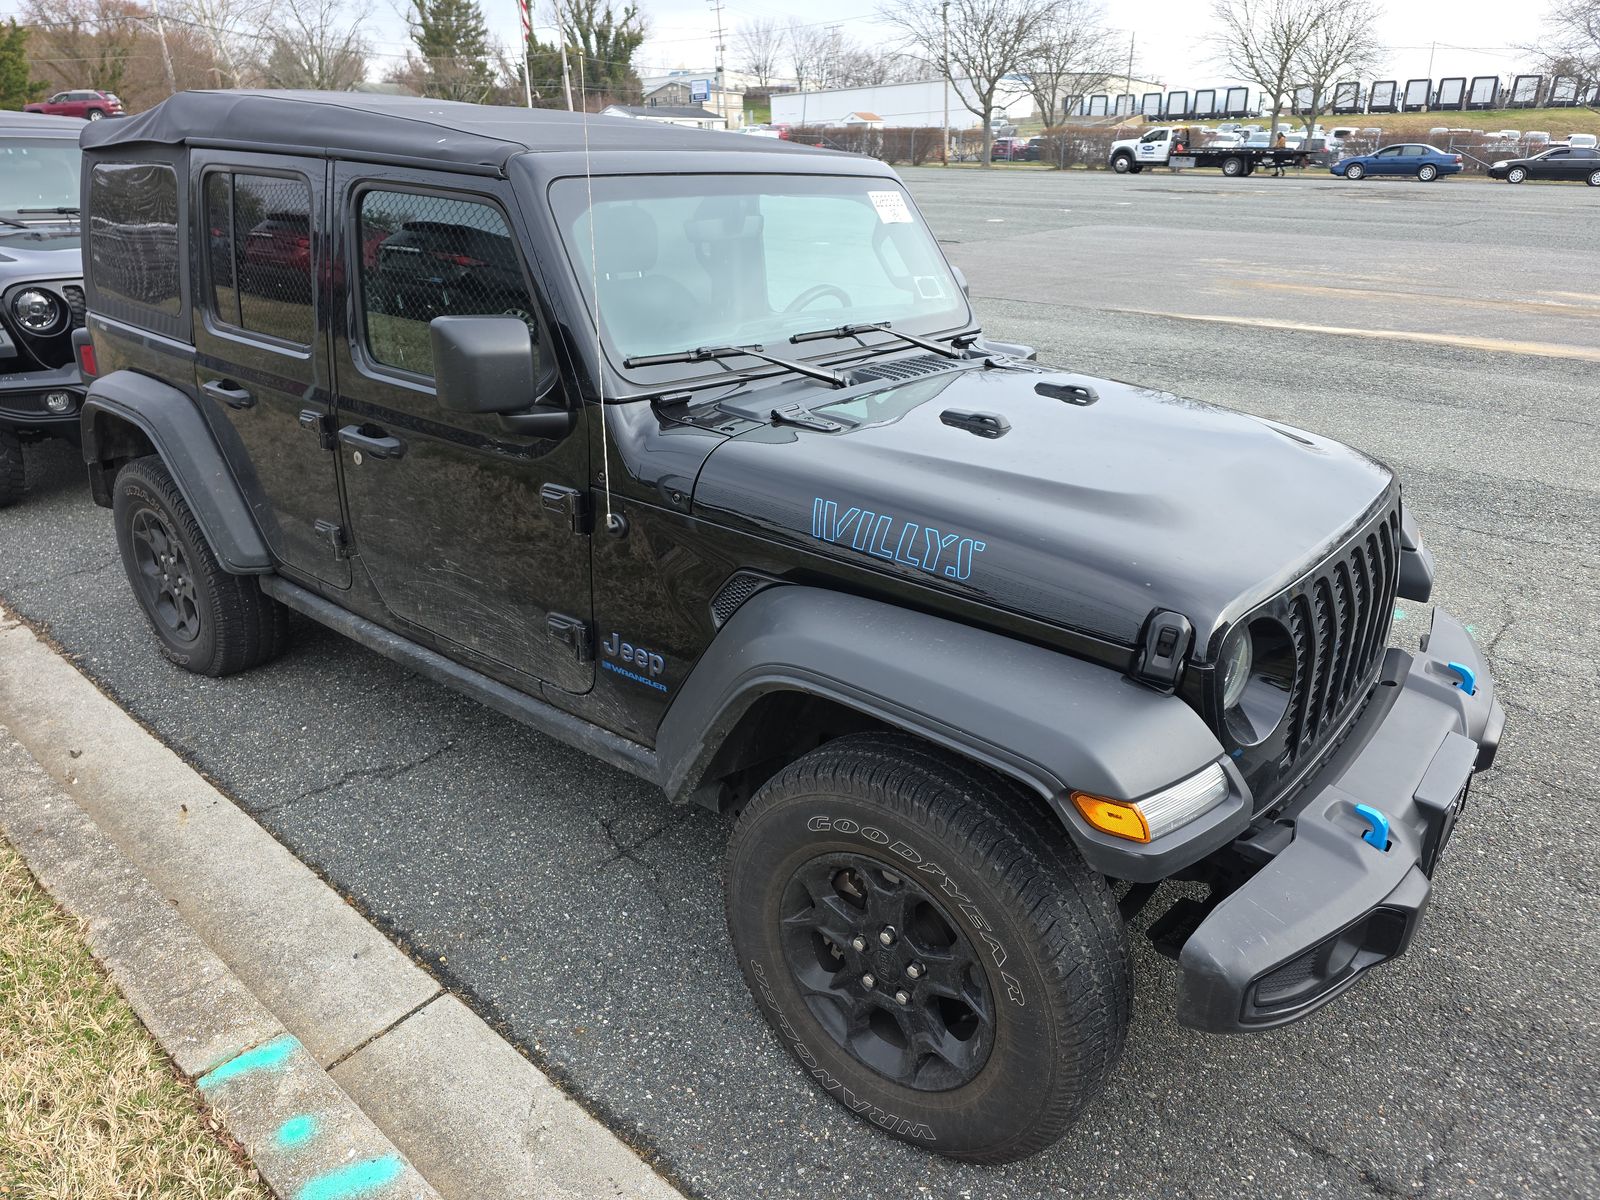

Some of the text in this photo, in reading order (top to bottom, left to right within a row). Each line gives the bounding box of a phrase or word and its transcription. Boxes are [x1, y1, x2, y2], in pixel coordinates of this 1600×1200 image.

[813, 497, 986, 579] WILLYS
[603, 632, 664, 677] Jeep
[610, 663, 667, 692] WRANGLER
[807, 816, 1025, 1006] GOODYEAR
[751, 959, 937, 1140] WRANGLER
